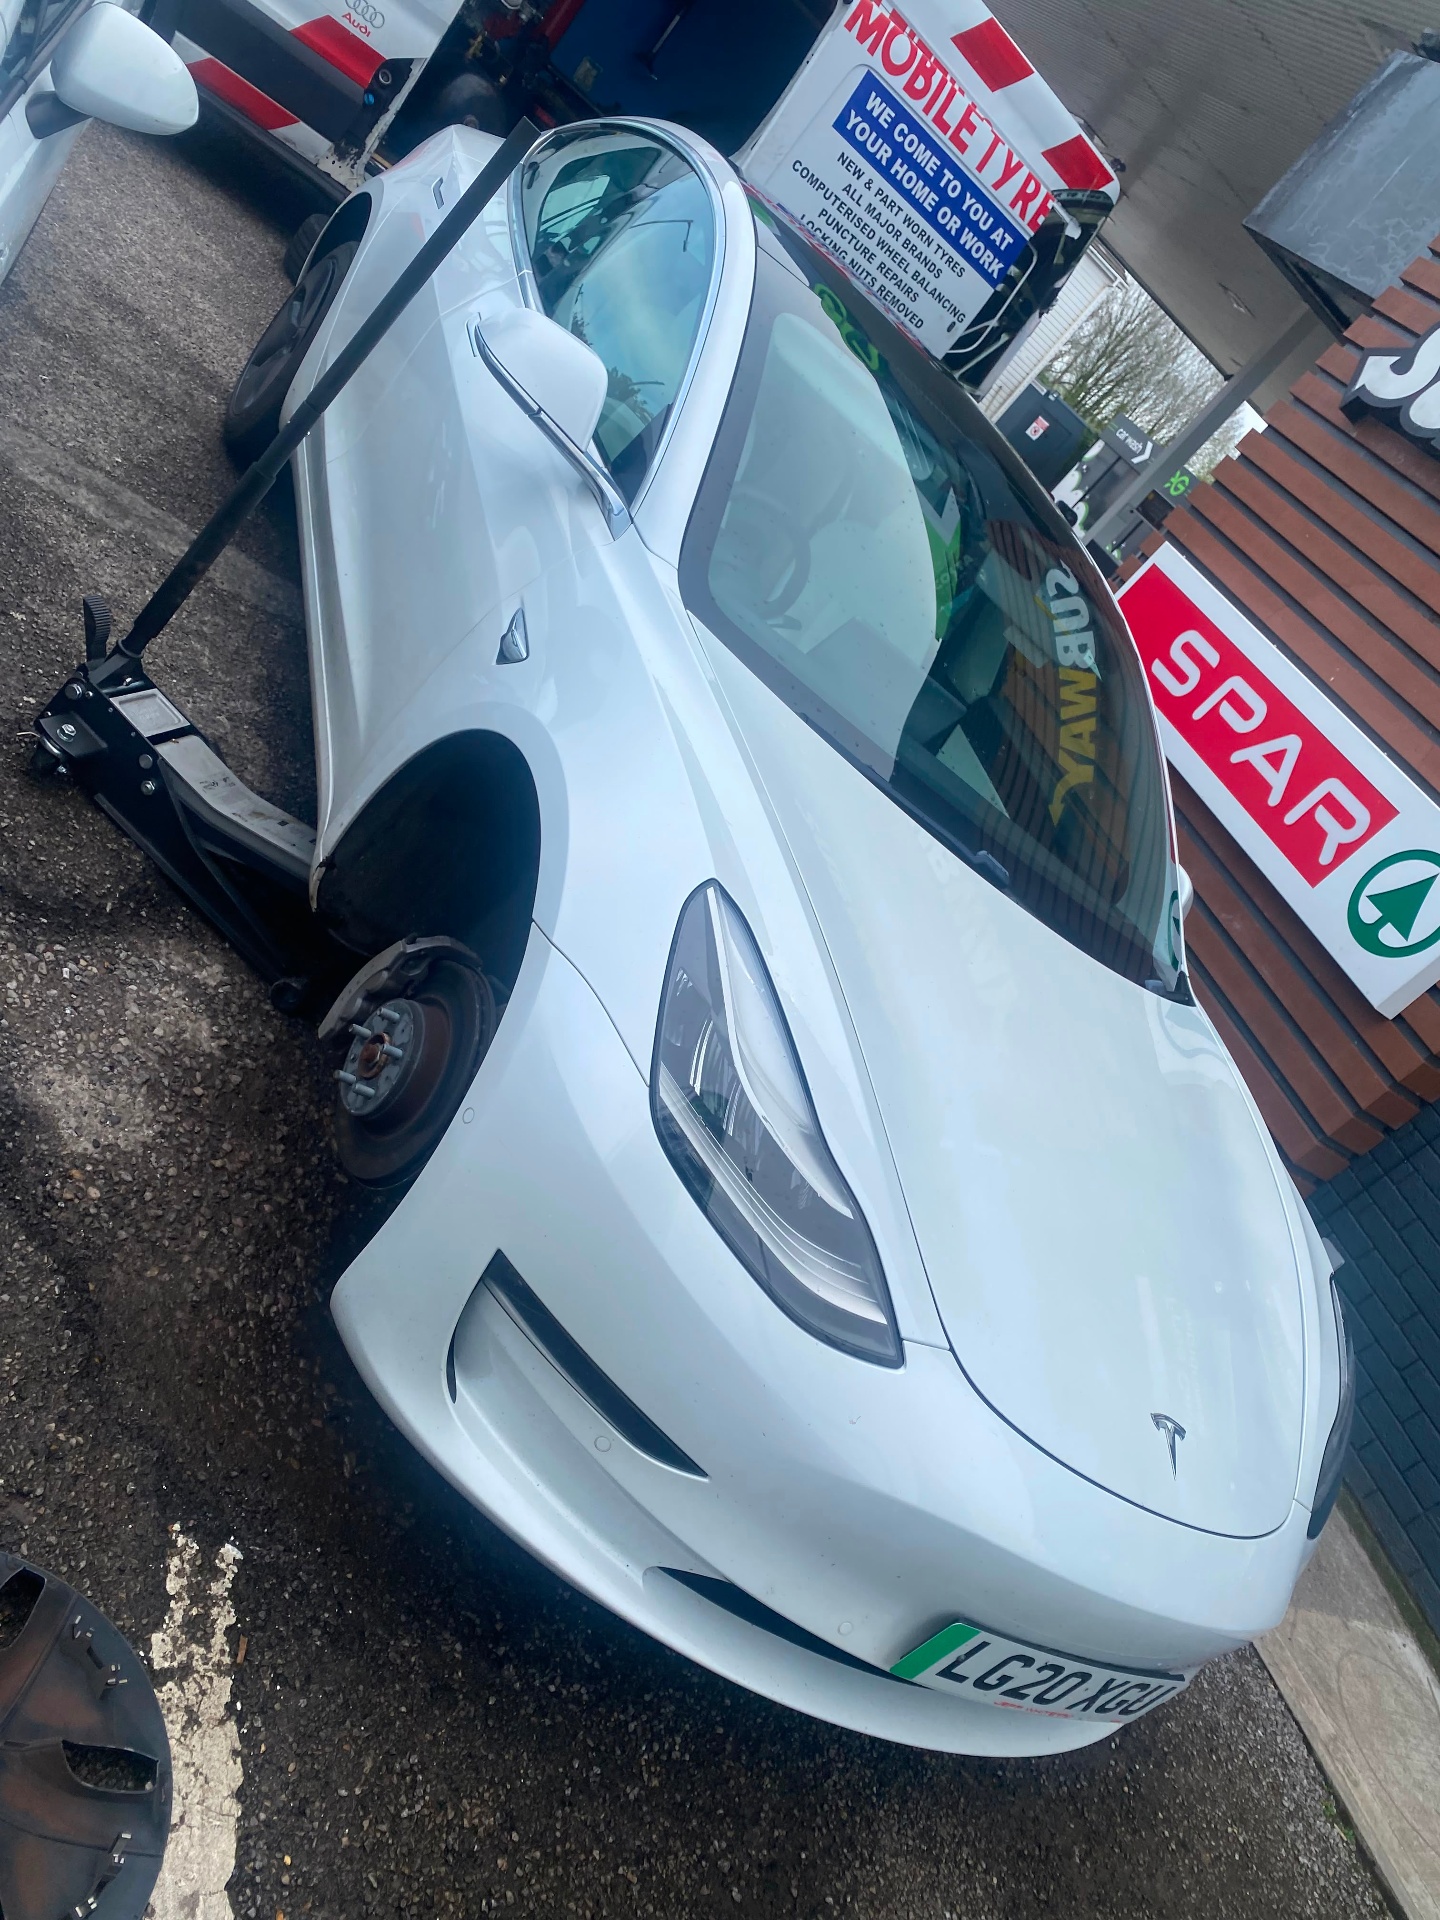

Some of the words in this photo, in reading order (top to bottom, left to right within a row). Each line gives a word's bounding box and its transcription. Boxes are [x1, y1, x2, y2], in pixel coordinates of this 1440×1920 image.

[341, 12, 371, 37] Audi
[844, 0, 977, 155] MOBILE
[976, 116, 1056, 234] TYRE
[866, 91, 896, 129] WE
[893, 123, 940, 177] COME
[939, 168, 962, 199] TO
[961, 191, 994, 231] YOU
[990, 227, 1014, 251] AT
[792, 159, 876, 240] COMPUTERISED
[876, 236, 911, 274] WHEEL
[910, 270, 966, 323] BALANCING
[818, 207, 877, 265] PUNCTURE
[877, 261, 919, 302] REPAIRS
[837, 152, 865, 181] NEW
[864, 178, 874, 191] &
[874, 187, 904, 217] PART
[902, 213, 935, 249] WORN
[934, 243, 966, 278] TYRES
[842, 183, 862, 207] ALL
[864, 203, 902, 241] MAJOR
[901, 239, 943, 279] BRANDS
[846, 109, 893, 167] YOUR
[890, 158, 940, 213] HOME
[936, 206, 961, 237] OR
[959, 227, 1005, 280] WORK
[848, 257, 877, 288] NUTS
[876, 284, 924, 329] REMOVED
[1151, 629, 1371, 866] SPAR
[935, 1641, 1092, 1705] LG20
[1065, 1678, 1177, 1716] XGU
